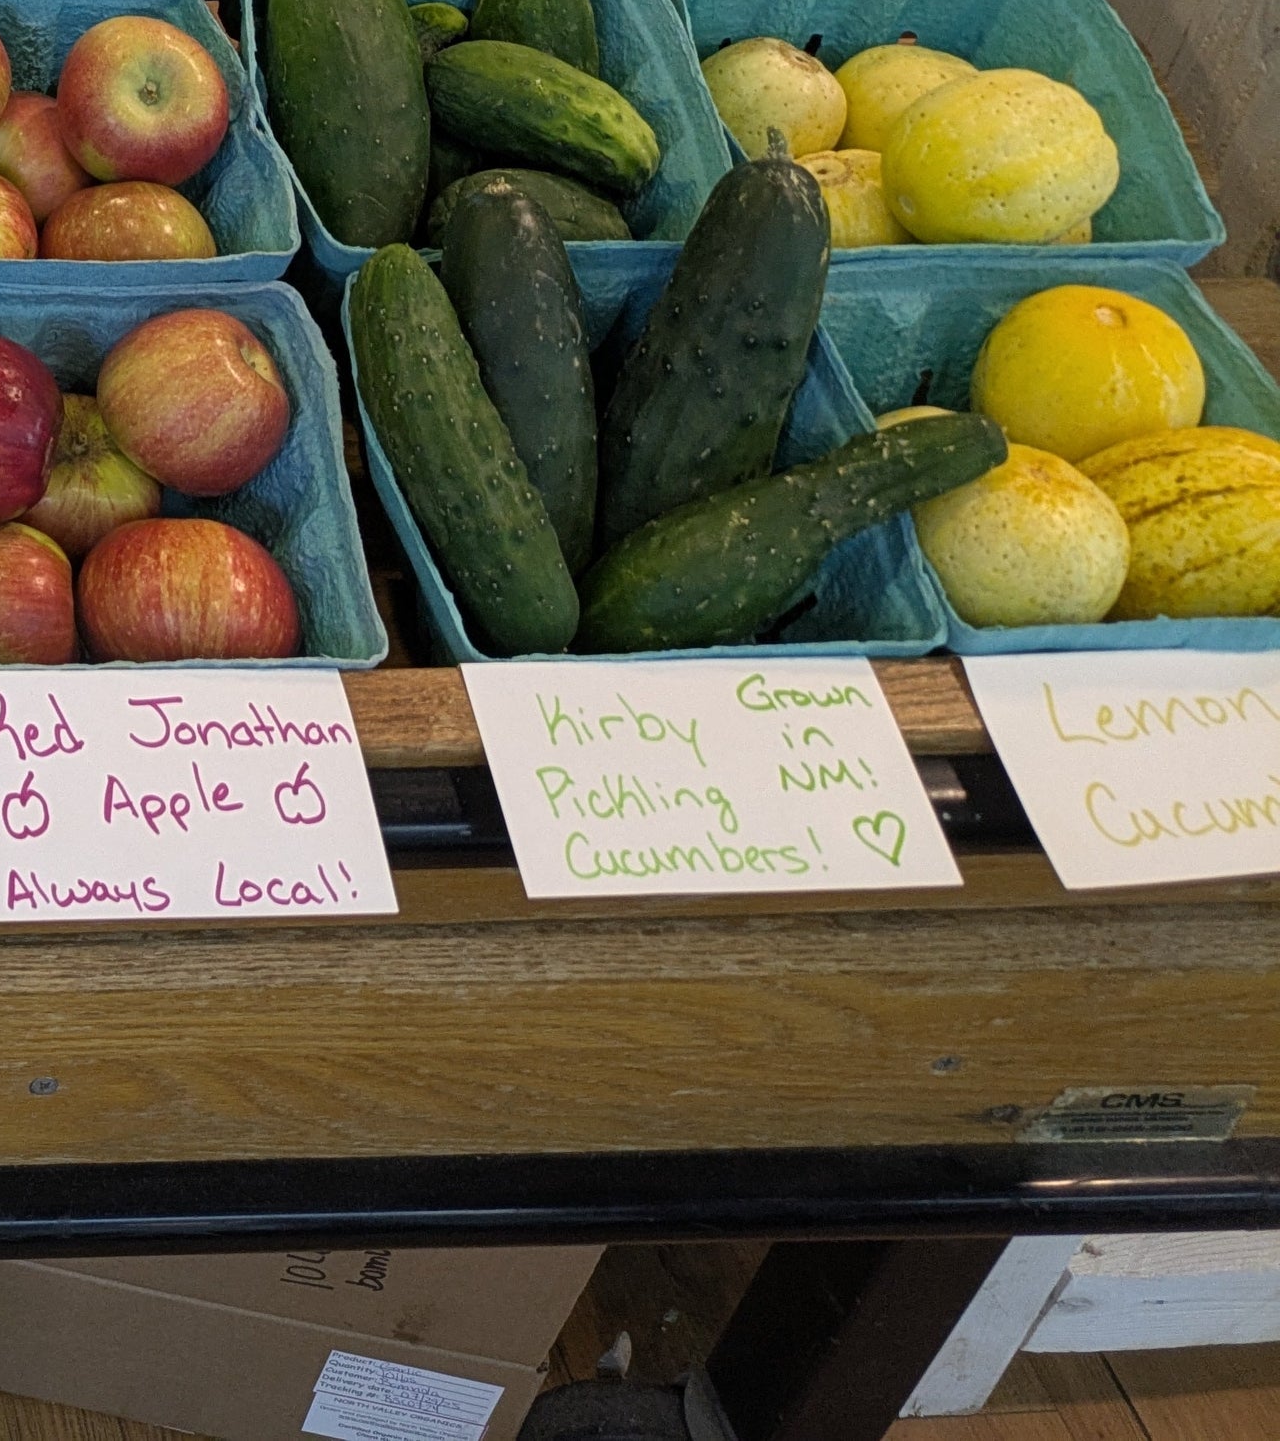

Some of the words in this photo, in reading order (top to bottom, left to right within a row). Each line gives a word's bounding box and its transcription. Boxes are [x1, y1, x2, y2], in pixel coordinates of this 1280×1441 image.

[736, 672, 873, 713] Grown
[1042, 681, 1280, 746] Lemon
[127, 695, 354, 751] Jonathan
[536, 692, 707, 768] Kirby
[780, 721, 835, 750] in
[102, 761, 245, 835] Apple
[535, 765, 740, 835] Pickling
[778, 756, 879, 793] NM!
[1084, 773, 1280, 848] Cucum
[564, 825, 831, 881] Cucumbers!
[6, 867, 172, 912] Always
[213, 861, 360, 907] Local!
[1100, 1091, 1186, 1109] CMS
[318, 1381, 363, 1396] Tracking
[321, 1373, 365, 1388] Delivery
[333, 1397, 369, 1409] NORTH
[371, 1405, 407, 1417] VALLEY
[409, 1413, 462, 1429] ORGANICS
